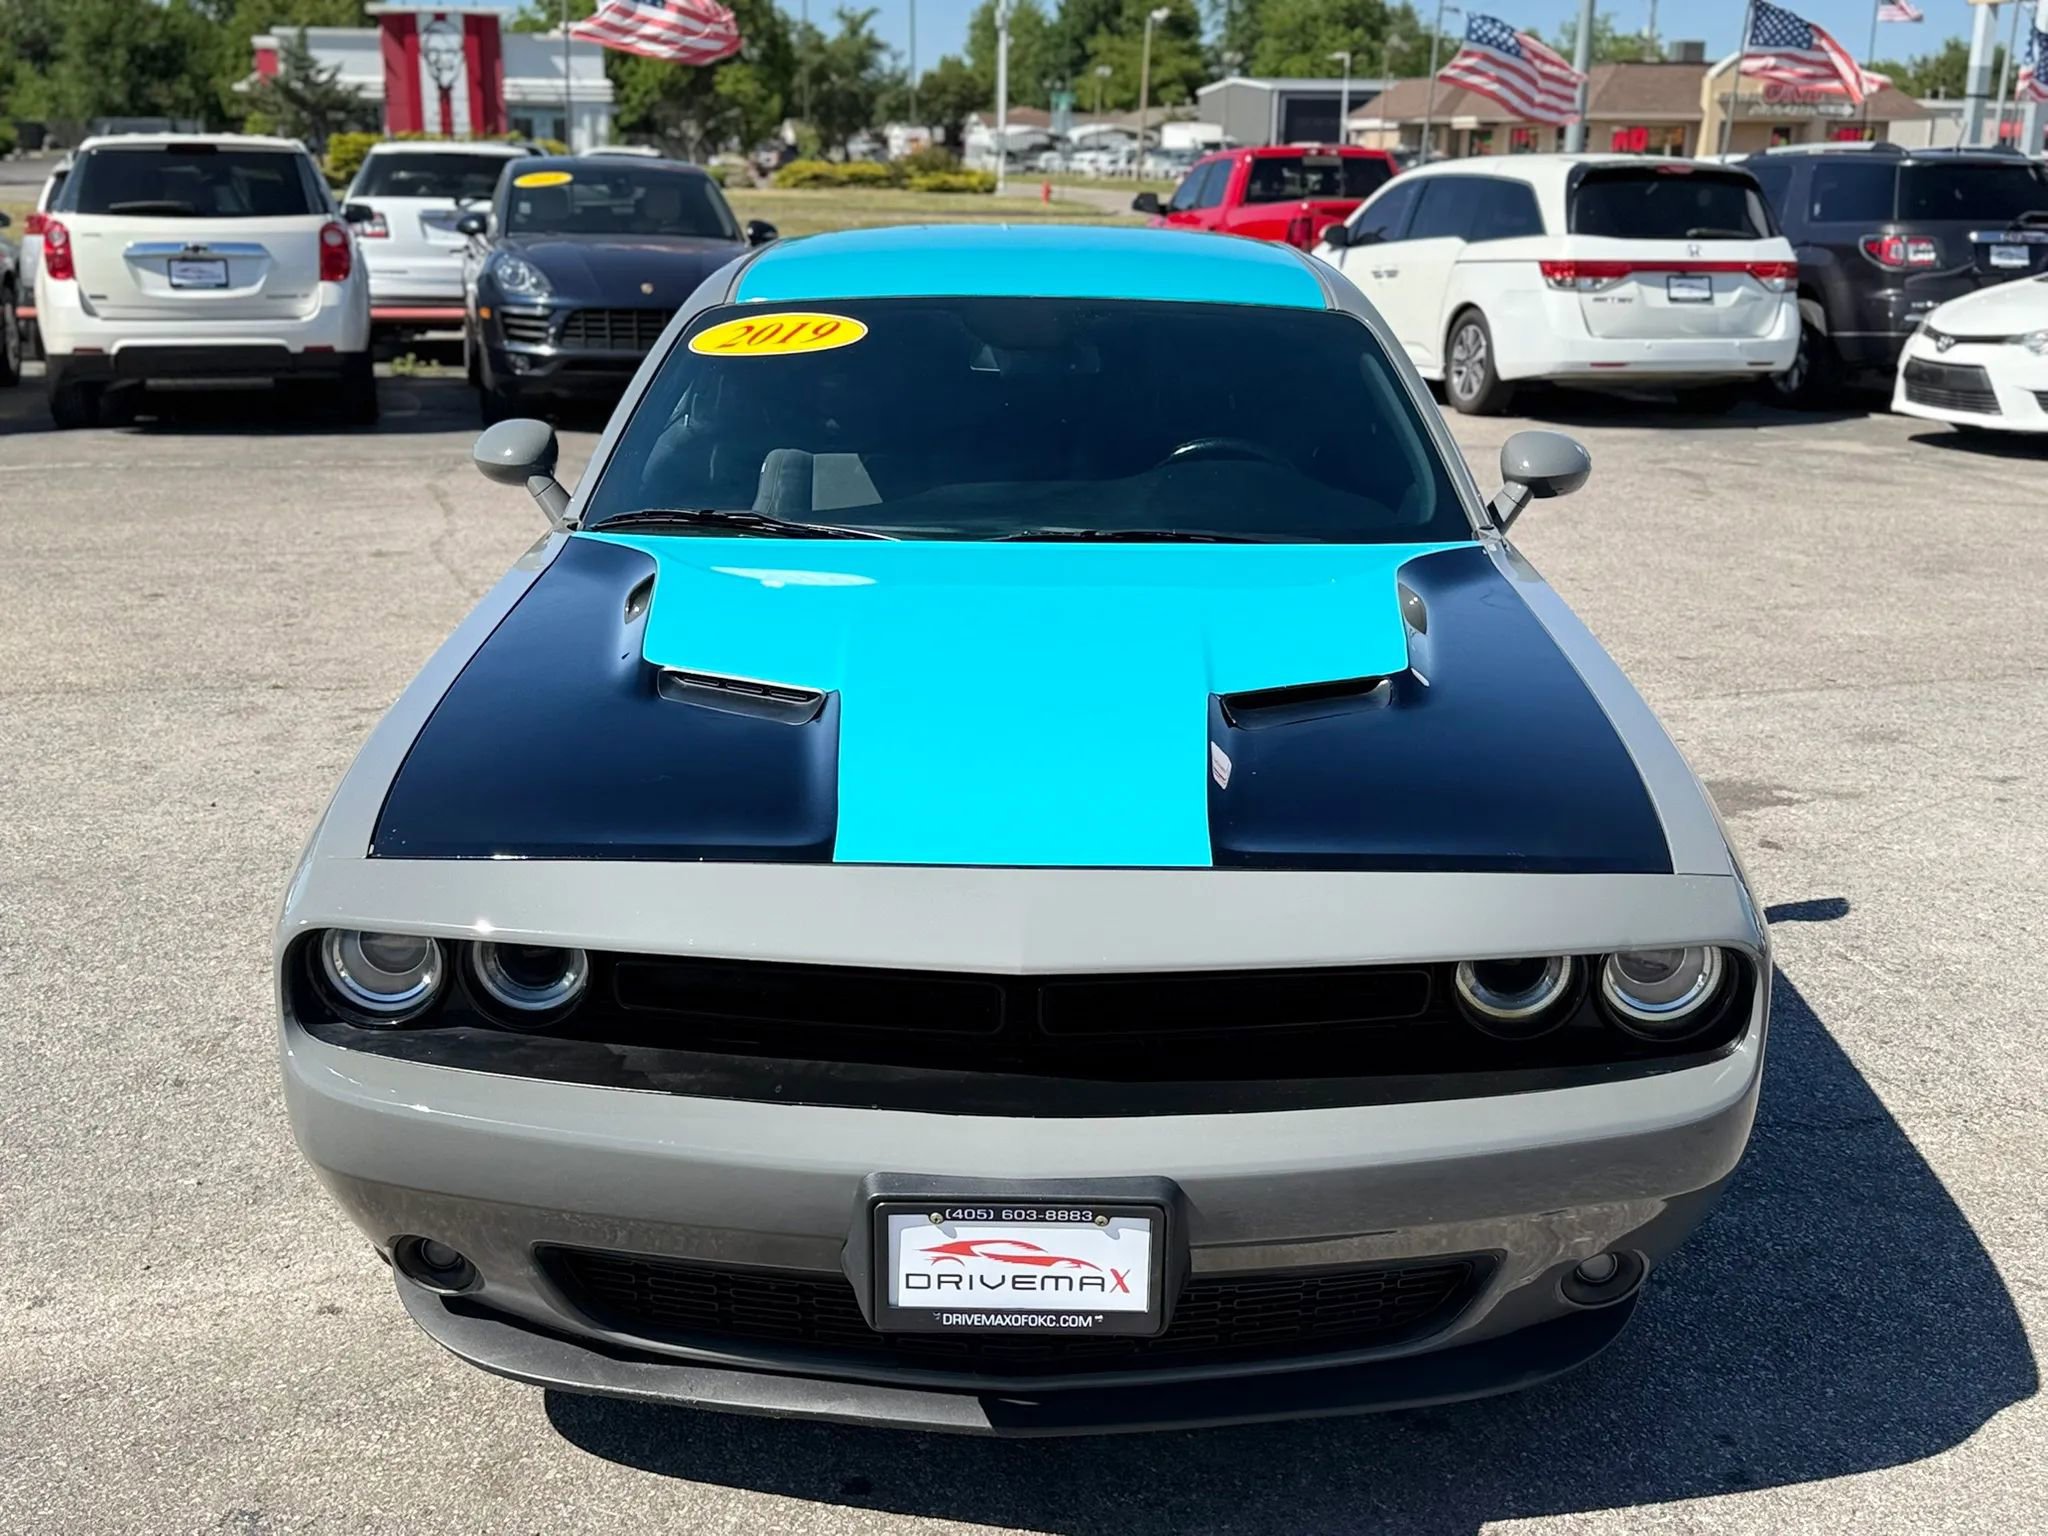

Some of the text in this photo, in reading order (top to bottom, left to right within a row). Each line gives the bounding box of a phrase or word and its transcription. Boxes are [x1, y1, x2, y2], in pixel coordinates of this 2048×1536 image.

[716, 321, 841, 349] 2019
[945, 1208, 1093, 1222] (405) 603-8883
[942, 1313, 1093, 1328] DRIVEMAXOFOKC.COM
